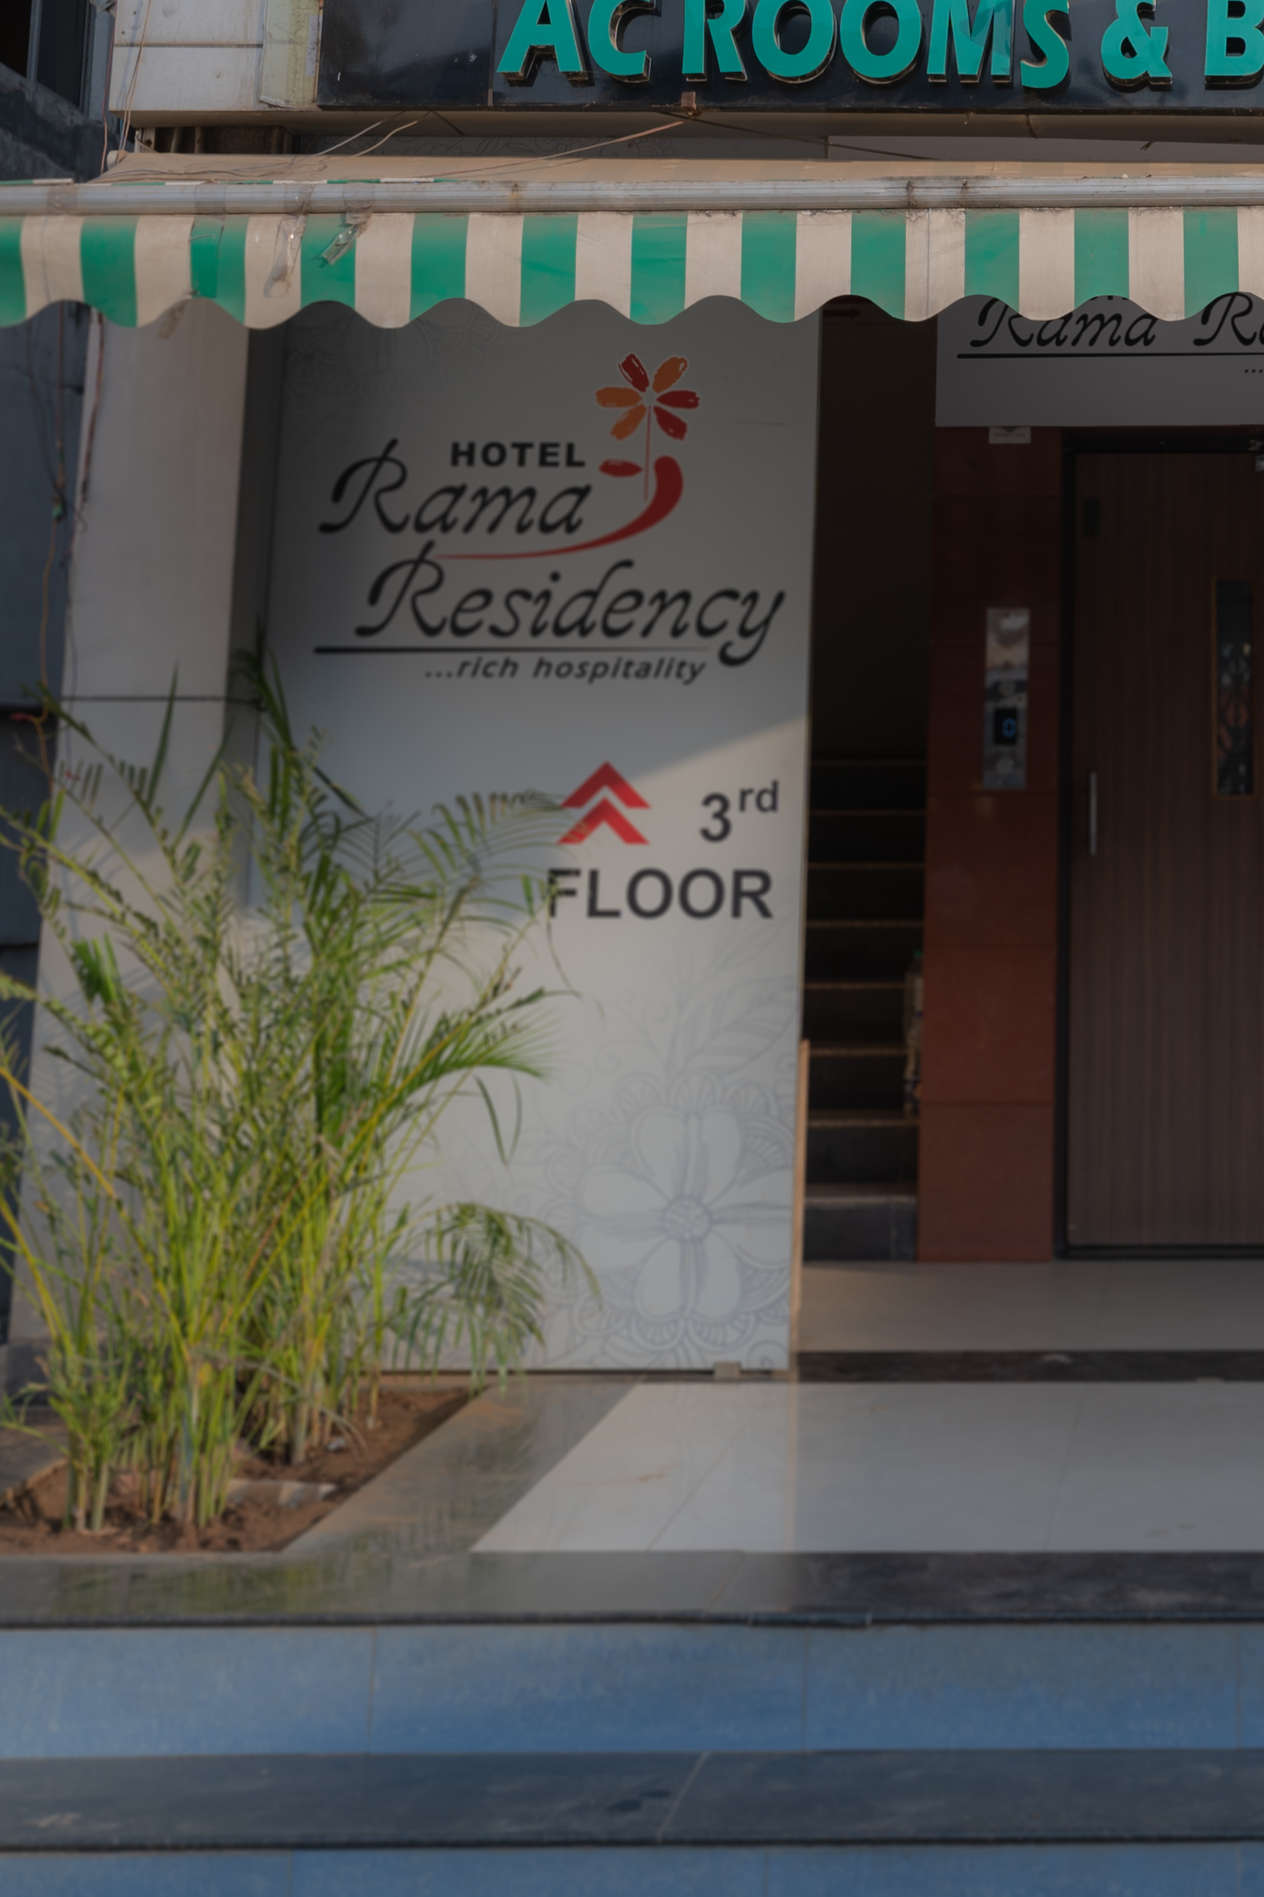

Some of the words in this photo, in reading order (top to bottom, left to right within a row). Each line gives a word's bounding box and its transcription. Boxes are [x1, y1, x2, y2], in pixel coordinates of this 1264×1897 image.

[450, 441, 586, 468] HOTEL
[318, 437, 592, 535] Rama
[354, 540, 787, 668] Residency
[425, 656, 519, 680] ...rich
[532, 656, 707, 685] hospitality
[700, 780, 778, 843] 3rd
[547, 867, 773, 920] FLOOR
